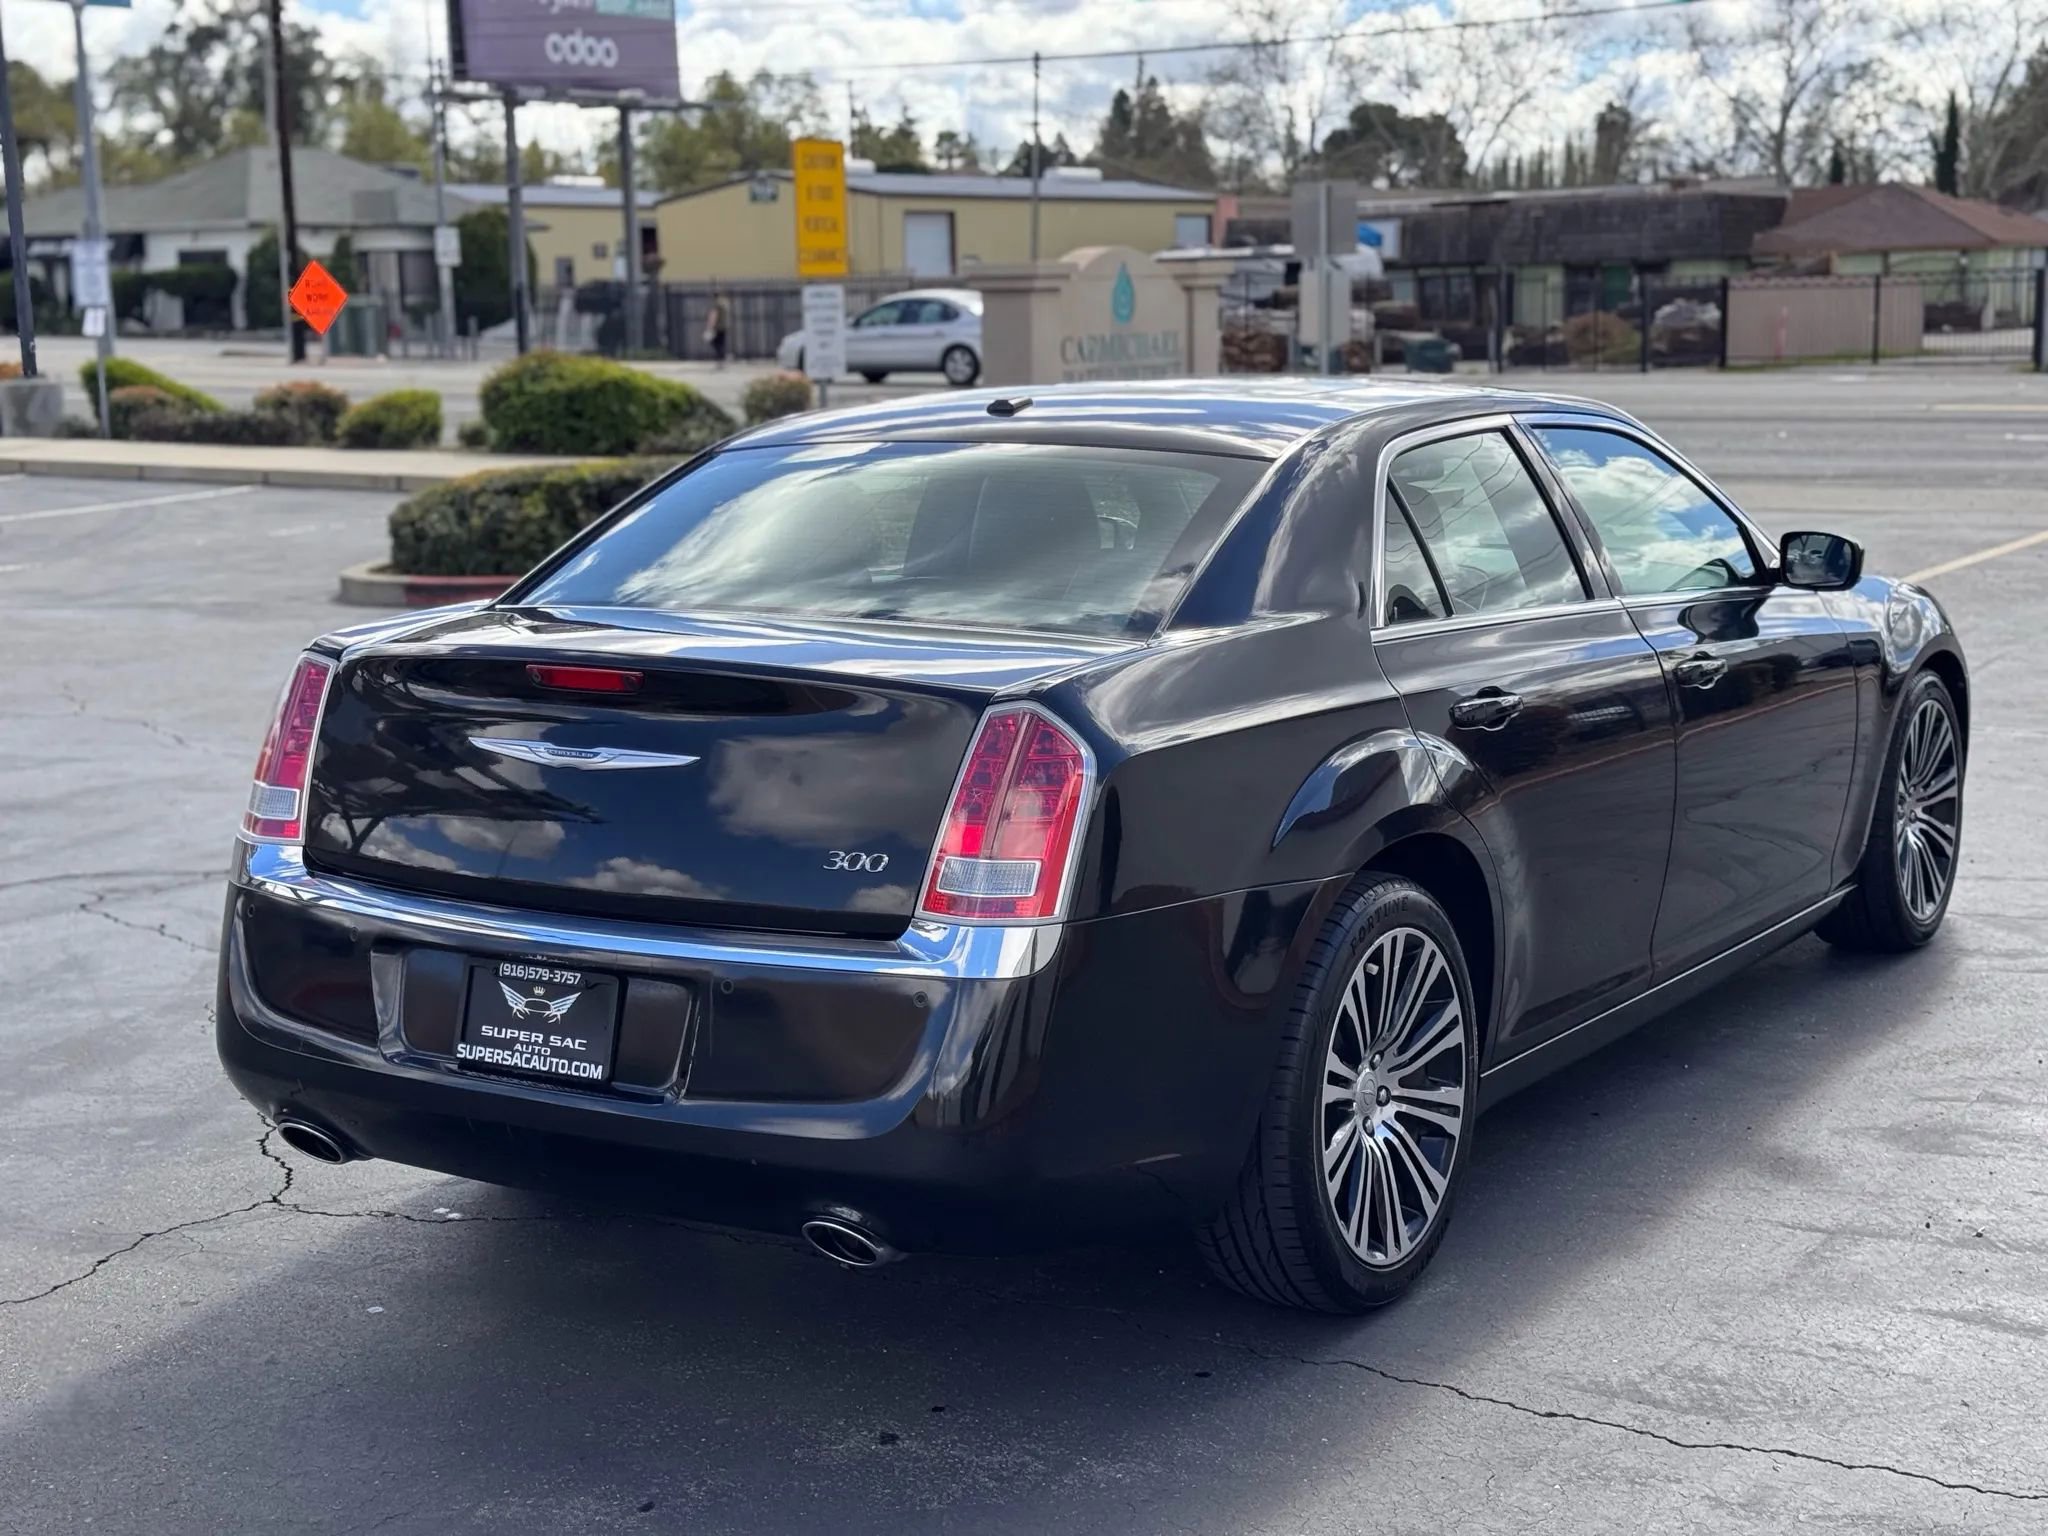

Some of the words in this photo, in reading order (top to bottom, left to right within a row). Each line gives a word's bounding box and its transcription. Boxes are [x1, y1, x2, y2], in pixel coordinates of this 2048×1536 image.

[545, 28, 618, 68] odoo
[823, 850, 889, 873] 300
[1350, 896, 1408, 956] FORTUNE
[499, 962, 582, 985] (916)579-3757
[481, 1025, 544, 1044] SUPER
[549, 1035, 588, 1051] SAC
[513, 1043, 551, 1056] AUTO
[456, 1043, 603, 1080] SUPERSACAUTO.COM
